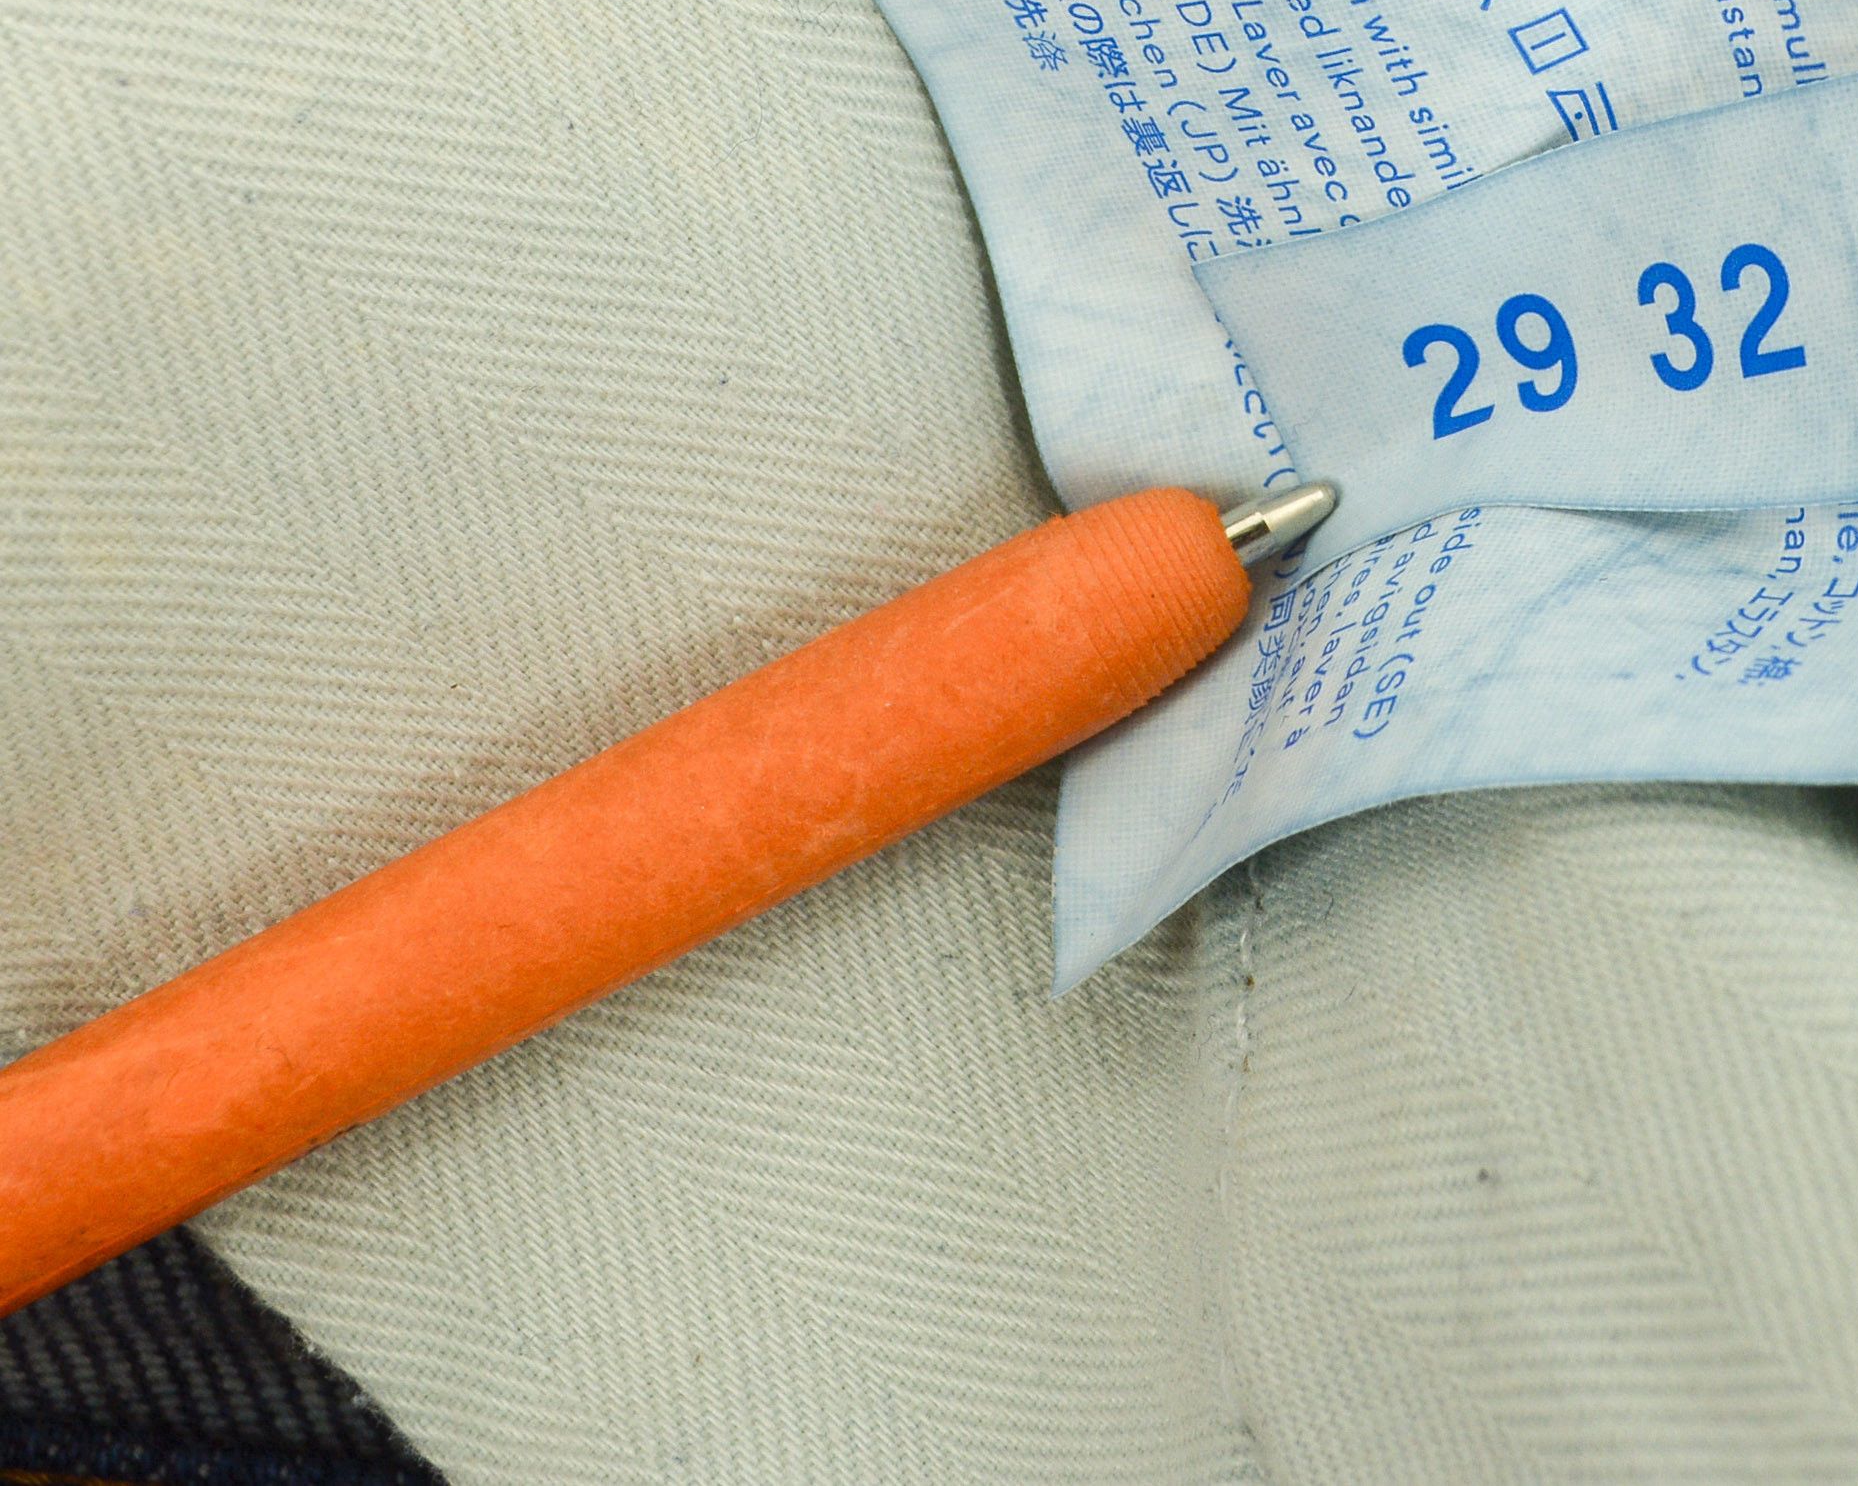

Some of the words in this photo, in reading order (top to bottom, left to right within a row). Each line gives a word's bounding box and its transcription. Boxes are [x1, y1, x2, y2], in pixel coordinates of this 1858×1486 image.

[1363, 14, 1428, 96] with
[1167, 100, 1240, 182] (JP)
[1217, 86, 1272, 147] Mit
[1290, 114, 1349, 202] avec
[1316, 46, 1415, 209] liknande
[1401, 292, 1579, 441] 29
[1636, 242, 1808, 393] 32
[1325, 553, 1413, 728] avigsidan
[1398, 583, 1437, 641] out
[1353, 652, 1414, 740] (SE)
